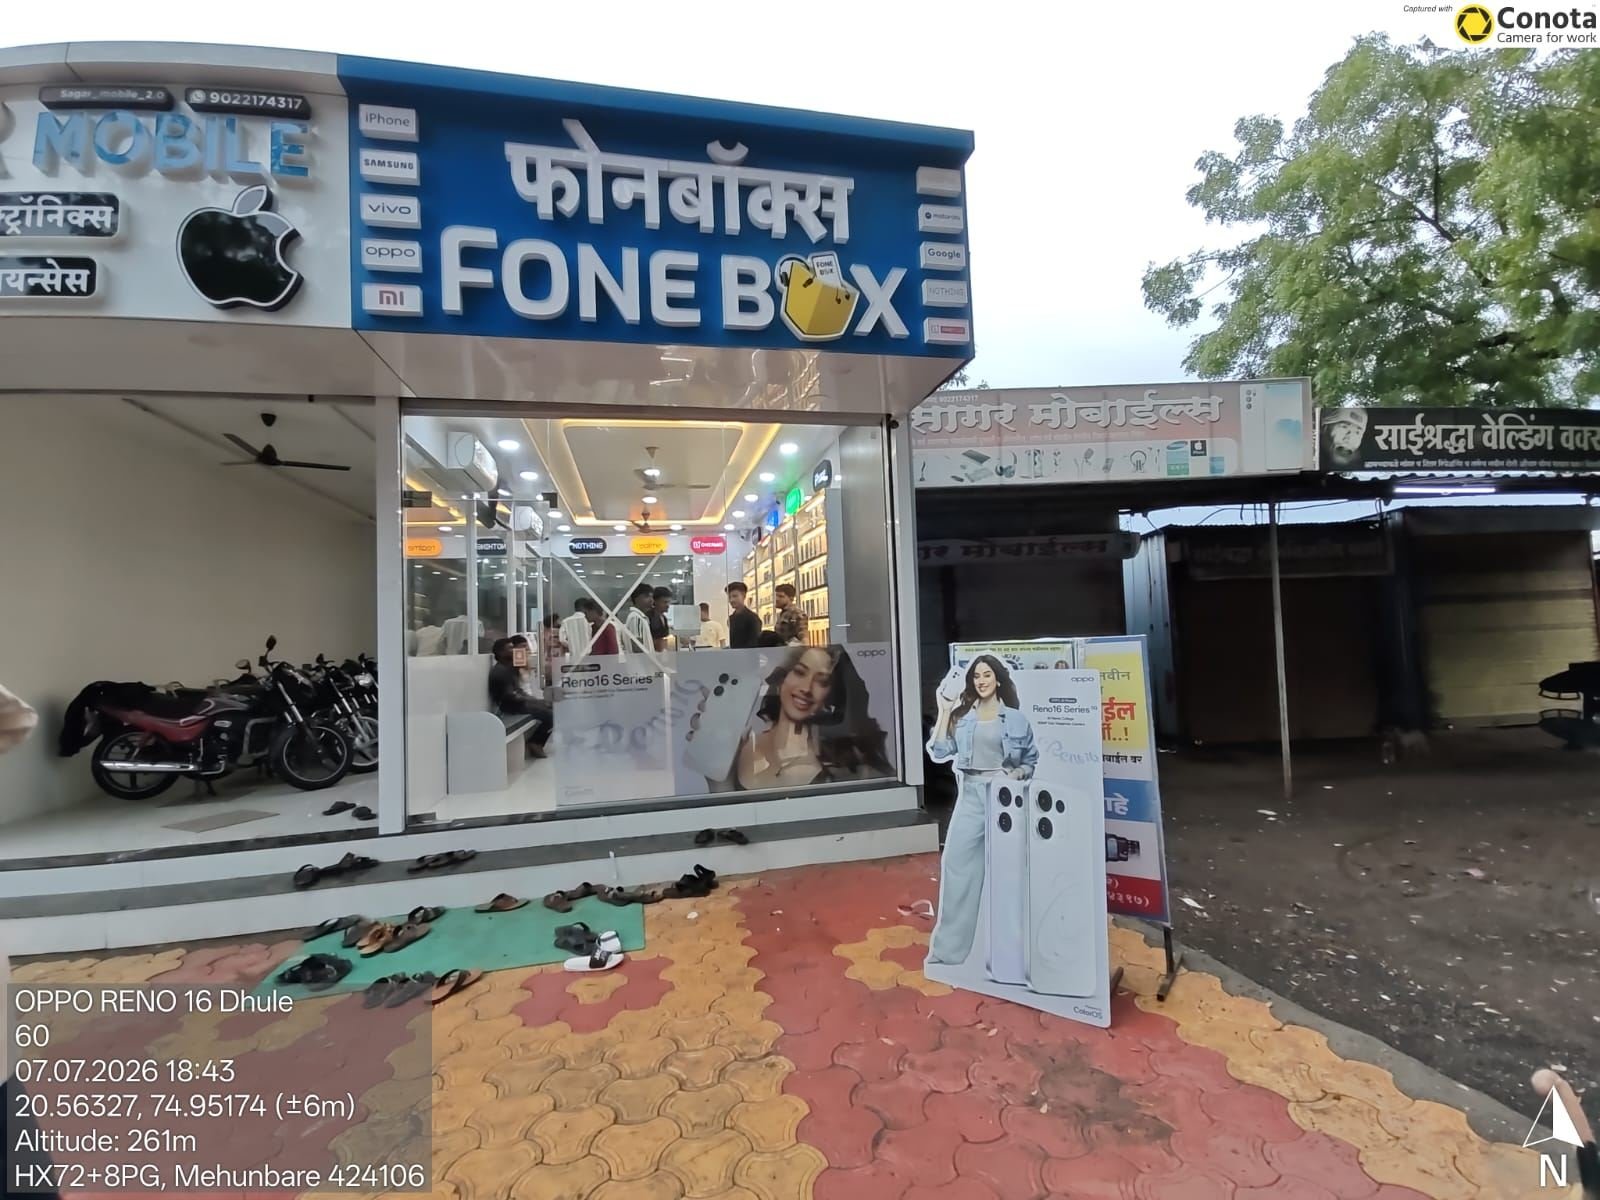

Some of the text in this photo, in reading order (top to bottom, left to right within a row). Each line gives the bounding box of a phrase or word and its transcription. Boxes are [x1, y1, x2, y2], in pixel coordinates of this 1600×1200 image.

[209, 91, 303, 110] 9022174317
[364, 111, 411, 128] iPhone
[32, 110, 310, 178] MOBILE
[363, 157, 415, 171] SAMSUNG
[503, 117, 855, 245] फोनबॉक्स
[0, 194, 115, 236] ट्रॉनिक्स
[367, 202, 412, 216] vivo
[365, 245, 416, 259] oppo
[927, 247, 961, 261] Google
[0, 257, 91, 294] यन्सेस
[440, 224, 703, 328] FONE
[1374, 413, 1476, 456] साईश्रद्धा
[1481, 413, 1554, 451] वेल्डिंग
[571, 542, 604, 550] NOTHING
[856, 649, 887, 659] oppo
[561, 674, 609, 688] Reno16
[612, 673, 653, 686] Series
[1032, 705, 1062, 713] Reno16
[1064, 705, 1090, 713] Series
